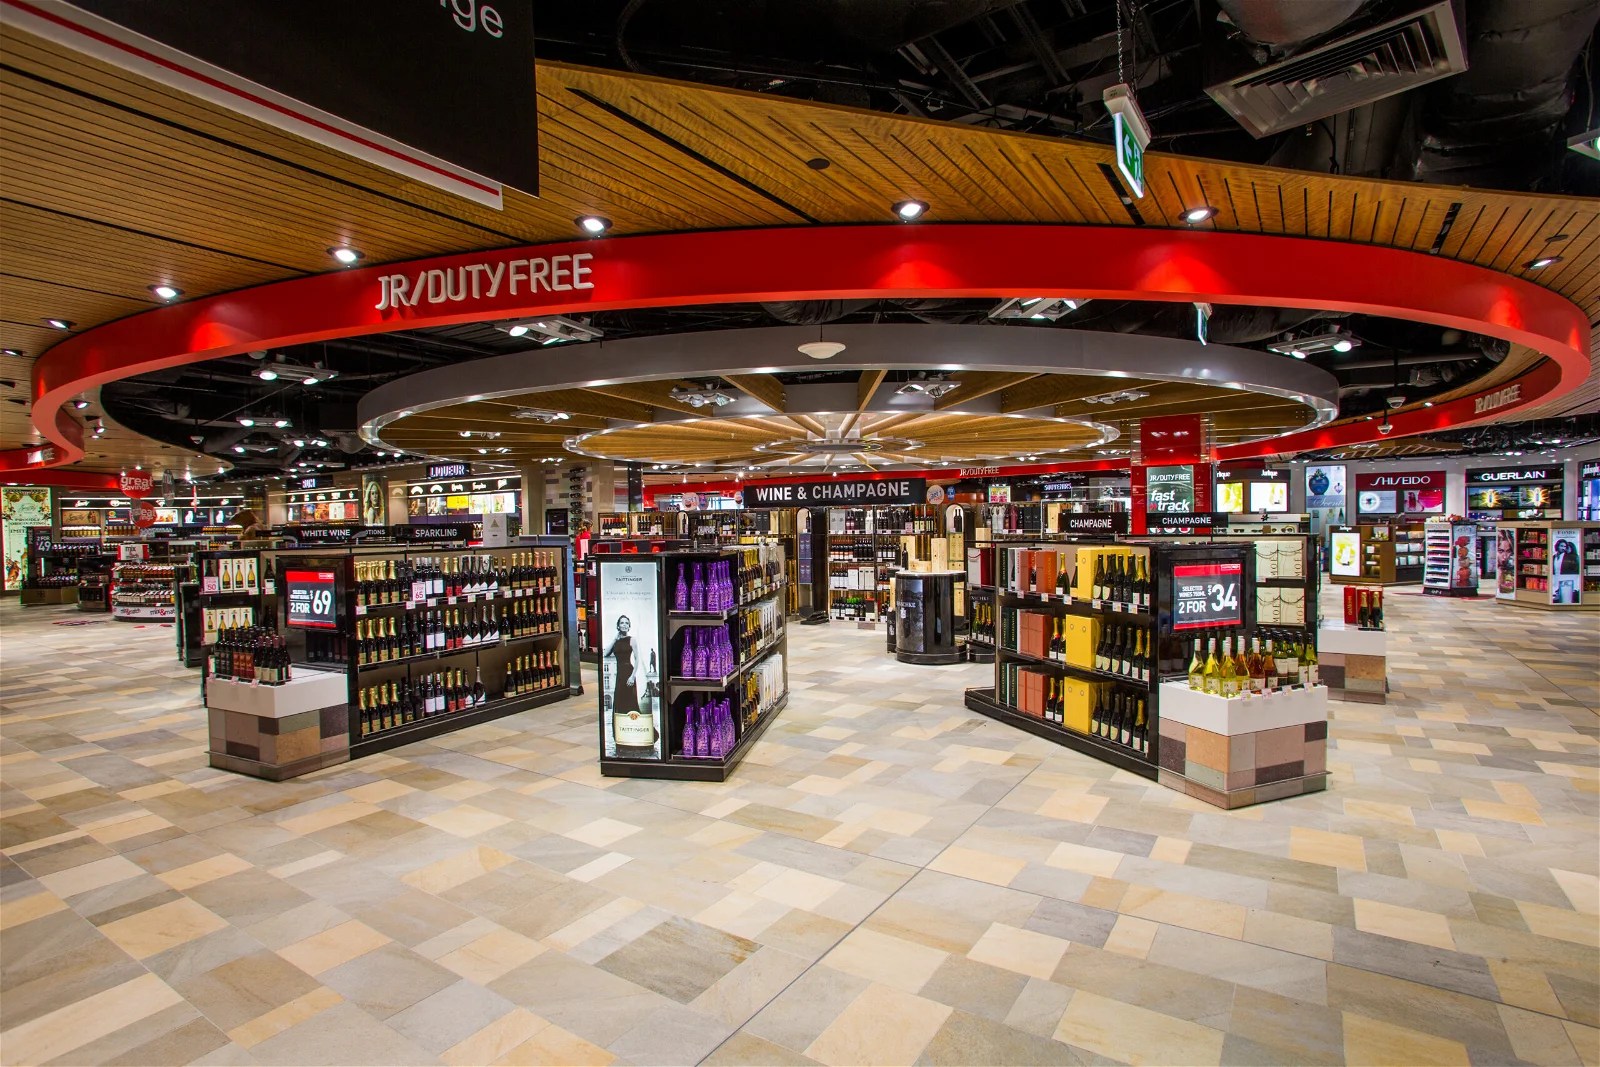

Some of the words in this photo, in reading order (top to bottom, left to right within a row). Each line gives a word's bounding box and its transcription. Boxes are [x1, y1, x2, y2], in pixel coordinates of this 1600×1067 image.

[441, 0, 503, 38] ge
[430, 465, 465, 477] LIQUEUR
[1481, 470, 1546, 481] GUERLAIN
[121, 475, 153, 487] great
[1370, 475, 1431, 486] SHISEIDO
[756, 487, 792, 501] WINE
[797, 486, 808, 500] &
[812, 481, 910, 499] CHAMPAGNE
[1151, 490, 1175, 502] fast
[1158, 499, 1190, 511] track
[1070, 518, 1112, 528] CHAMPAGNE
[1162, 516, 1212, 525] CHAMPAGNE
[301, 530, 328, 538] WHITE
[328, 528, 351, 537] WINE
[415, 528, 458, 538] SPARKLING
[290, 602, 296, 613] 2
[296, 602, 310, 613] FOR
[1178, 602, 1185, 614] 2
[1186, 600, 1207, 613] FOR
